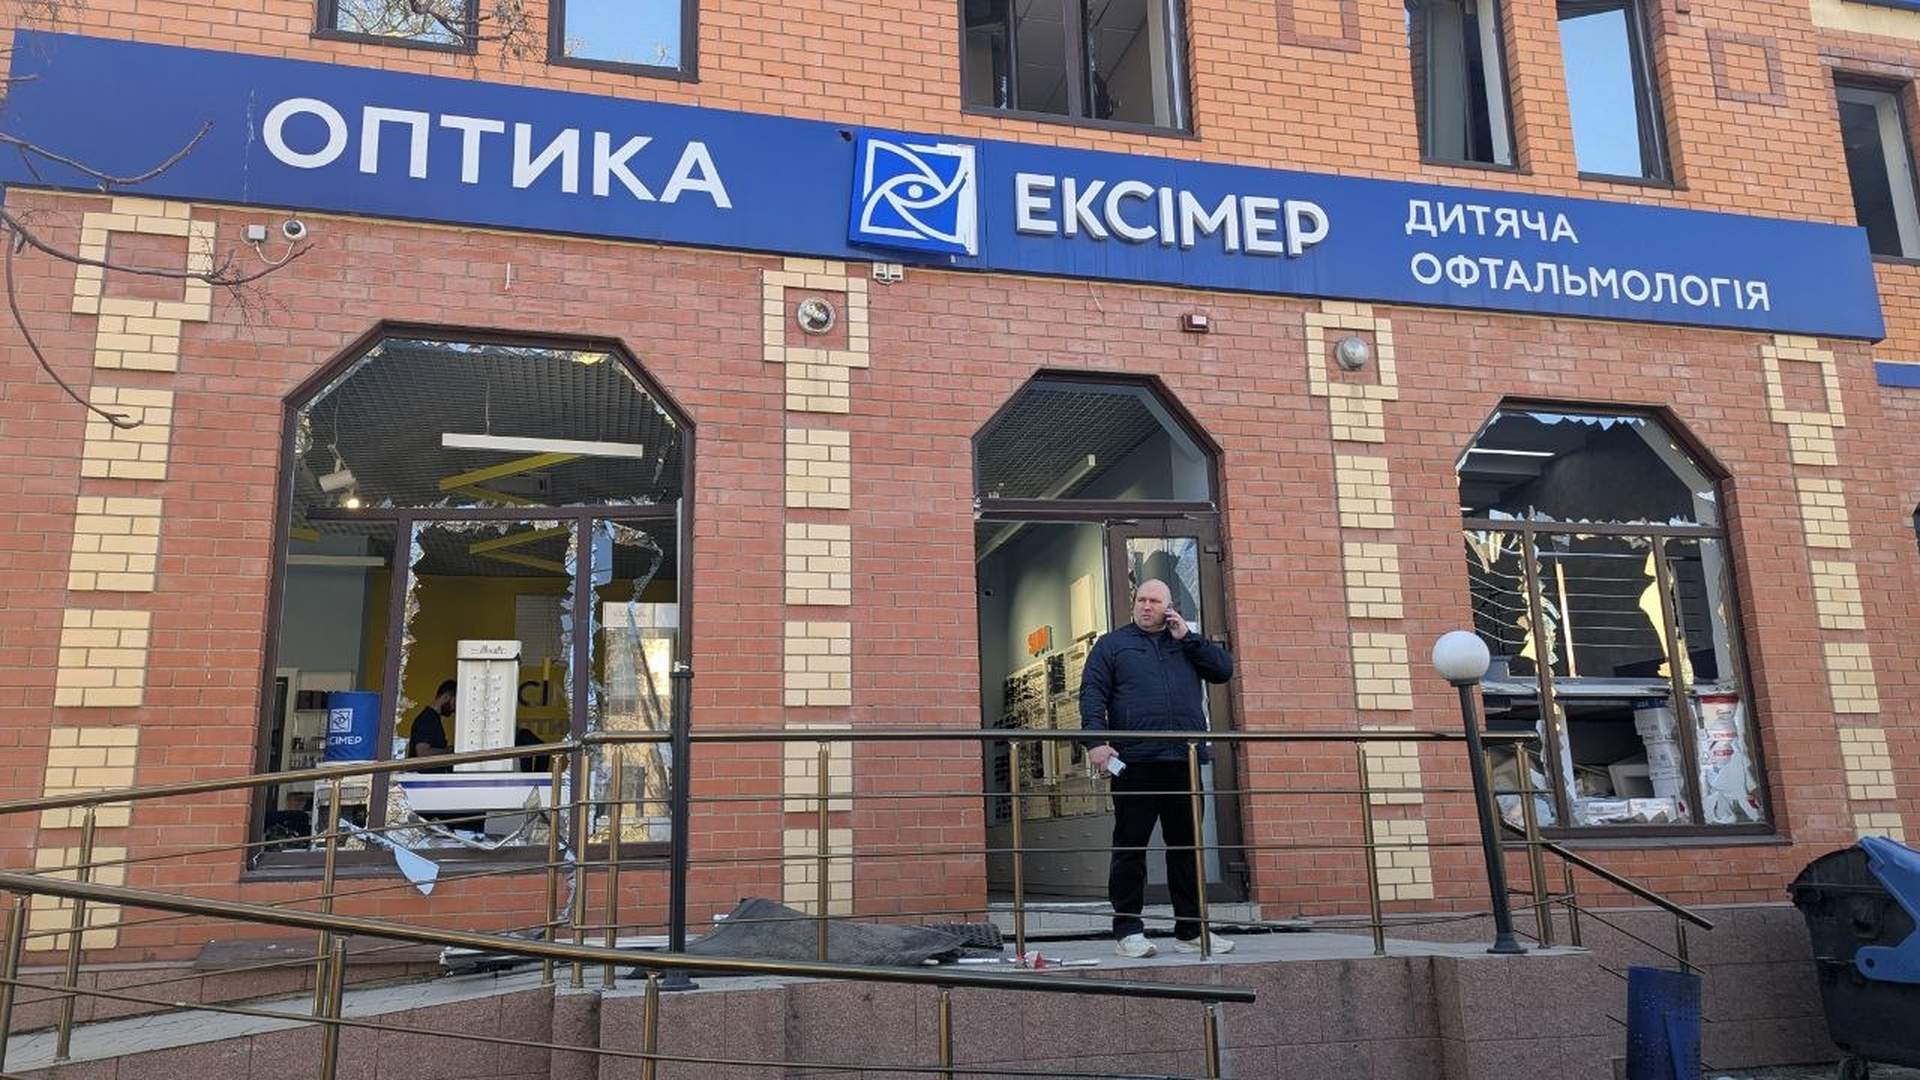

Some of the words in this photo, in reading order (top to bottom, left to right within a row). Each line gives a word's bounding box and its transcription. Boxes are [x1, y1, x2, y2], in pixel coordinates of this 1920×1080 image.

[263, 97, 733, 209] ОПТИКА
[1015, 171, 1330, 258] ЕКСІМЕР
[1405, 199, 1580, 244] ДИТЯЧА
[1410, 251, 1771, 312] ОФТАЛЬМОЛОГІЯ
